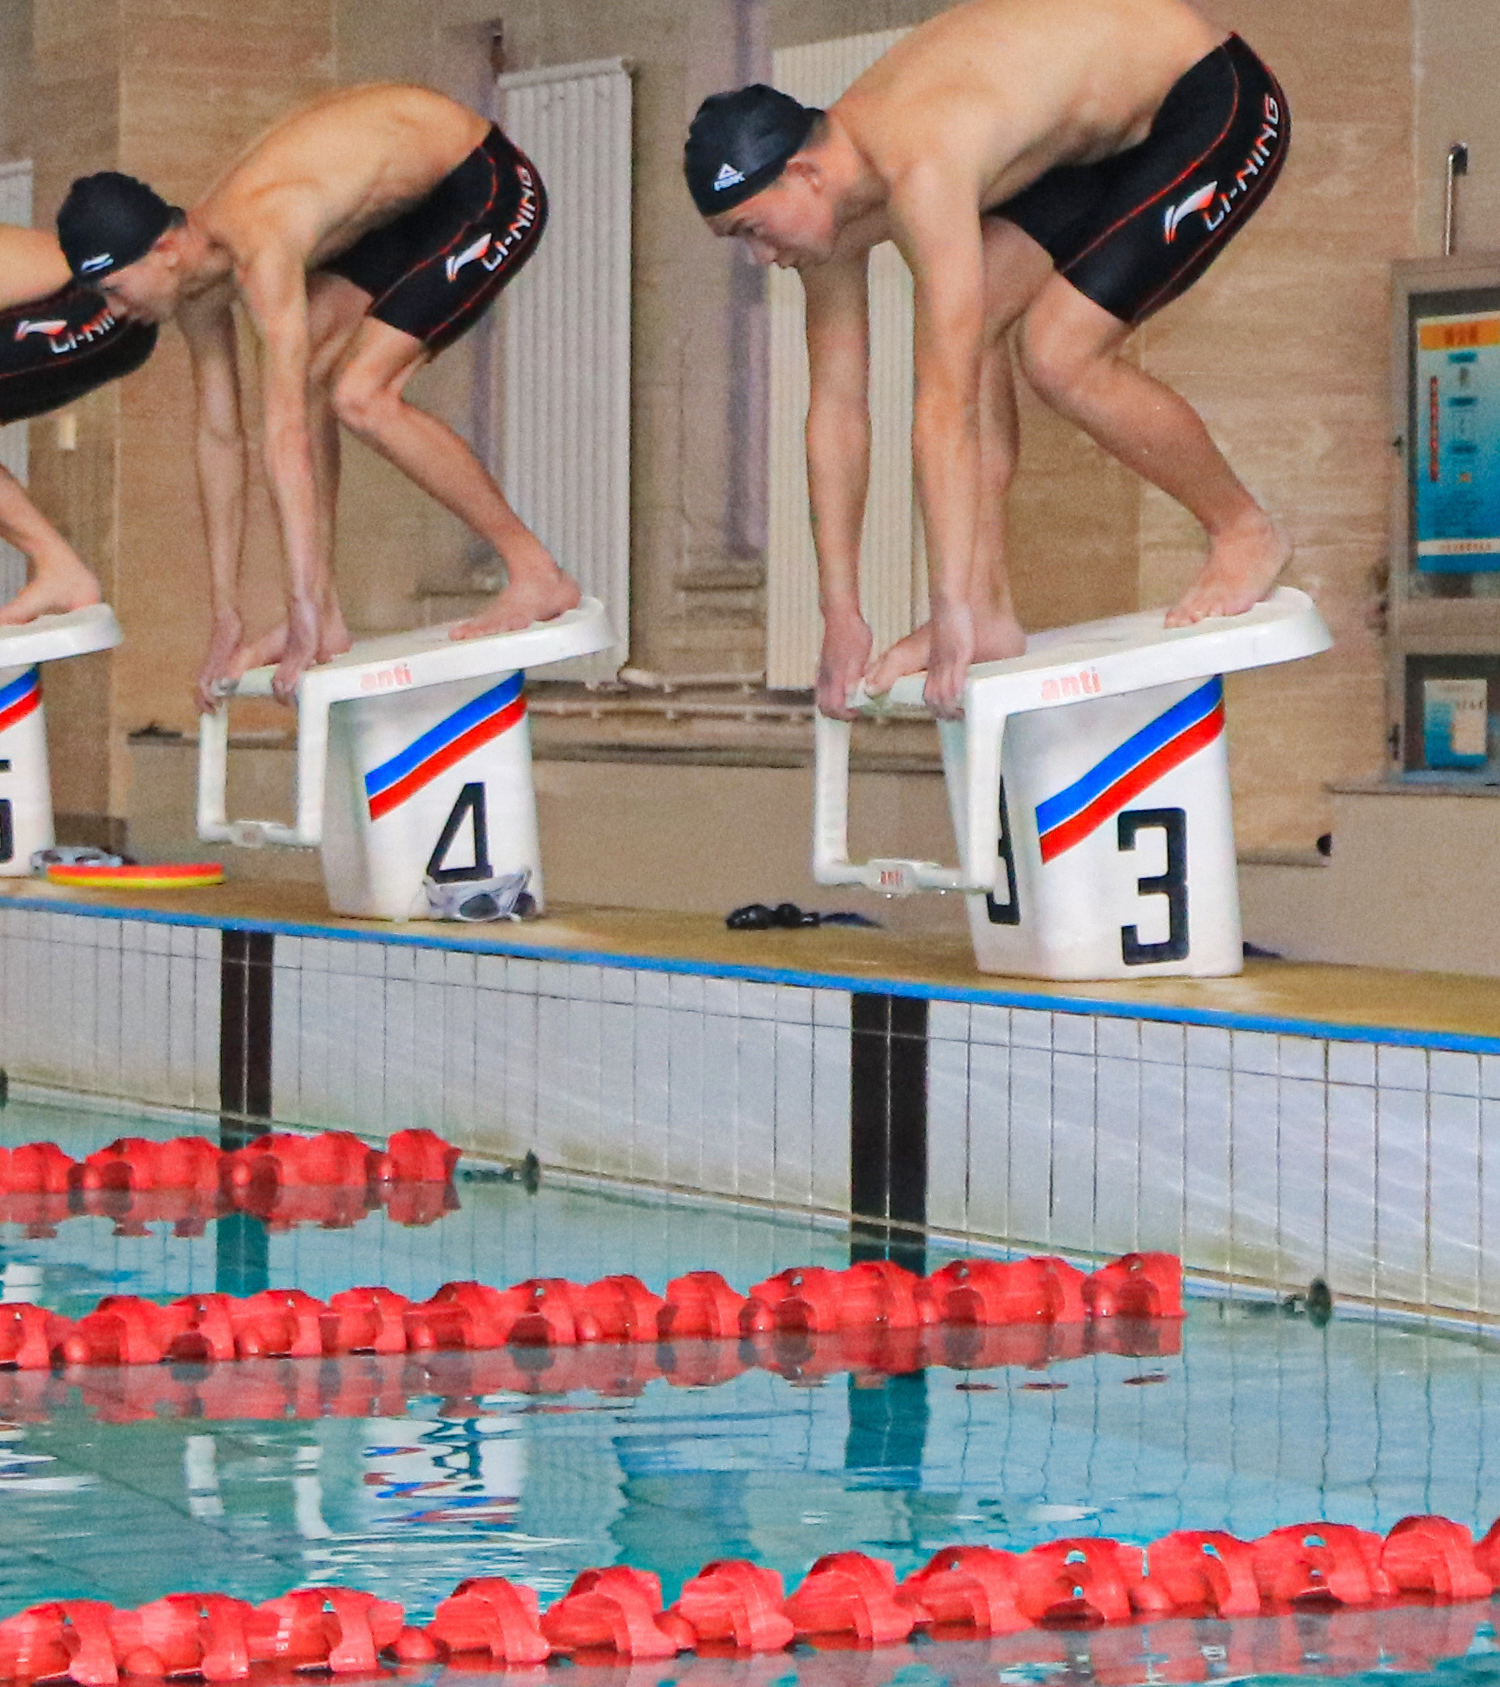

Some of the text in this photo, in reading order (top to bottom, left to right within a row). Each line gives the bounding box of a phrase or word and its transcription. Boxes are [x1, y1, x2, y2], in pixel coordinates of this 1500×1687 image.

[1202, 93, 1280, 232] LI-NING
[481, 164, 536, 272] LI-NING
[49, 308, 116, 354] LI-NI
[1041, 667, 1102, 701] anti
[426, 781, 494, 885] 4
[1117, 807, 1191, 967] 3
